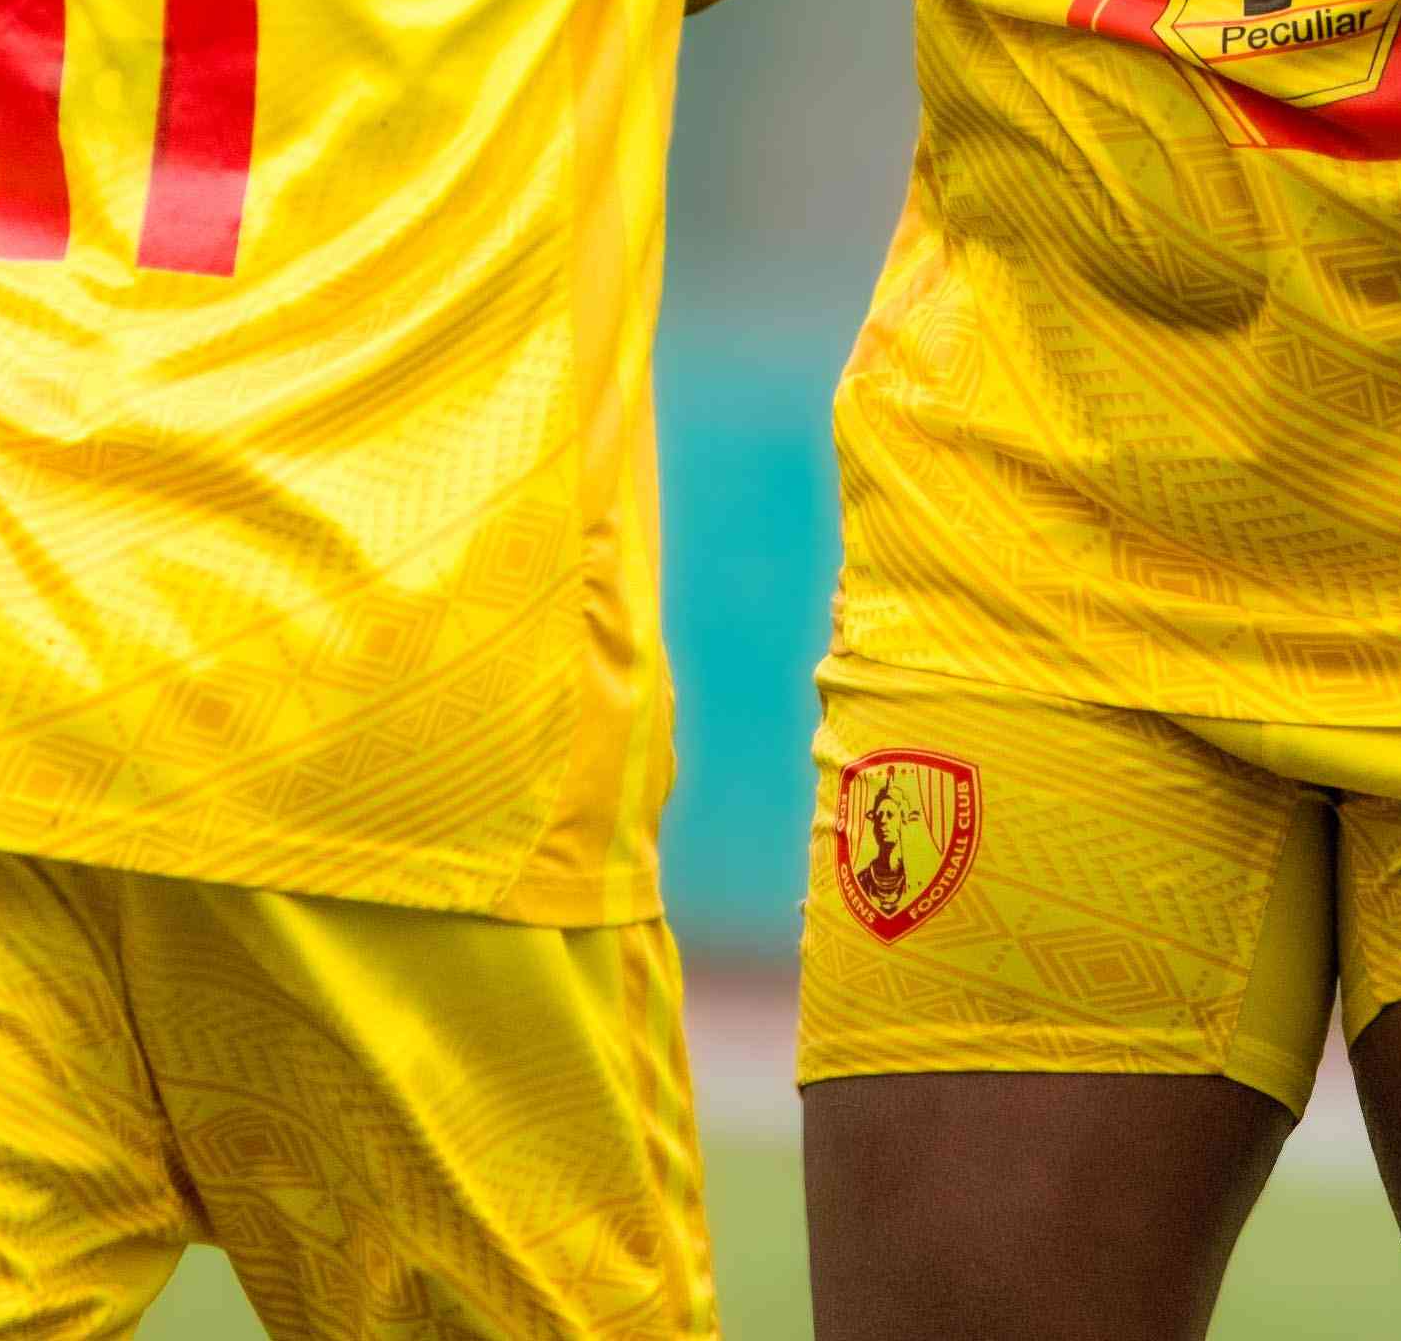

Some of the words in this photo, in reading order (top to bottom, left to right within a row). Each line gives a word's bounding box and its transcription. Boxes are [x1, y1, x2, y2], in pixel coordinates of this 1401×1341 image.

[1220, 6, 1374, 55] Peculiar
[840, 863, 876, 924] QUEENS
[909, 836, 969, 920] FOOTBALL
[957, 780, 971, 831] CLUB
